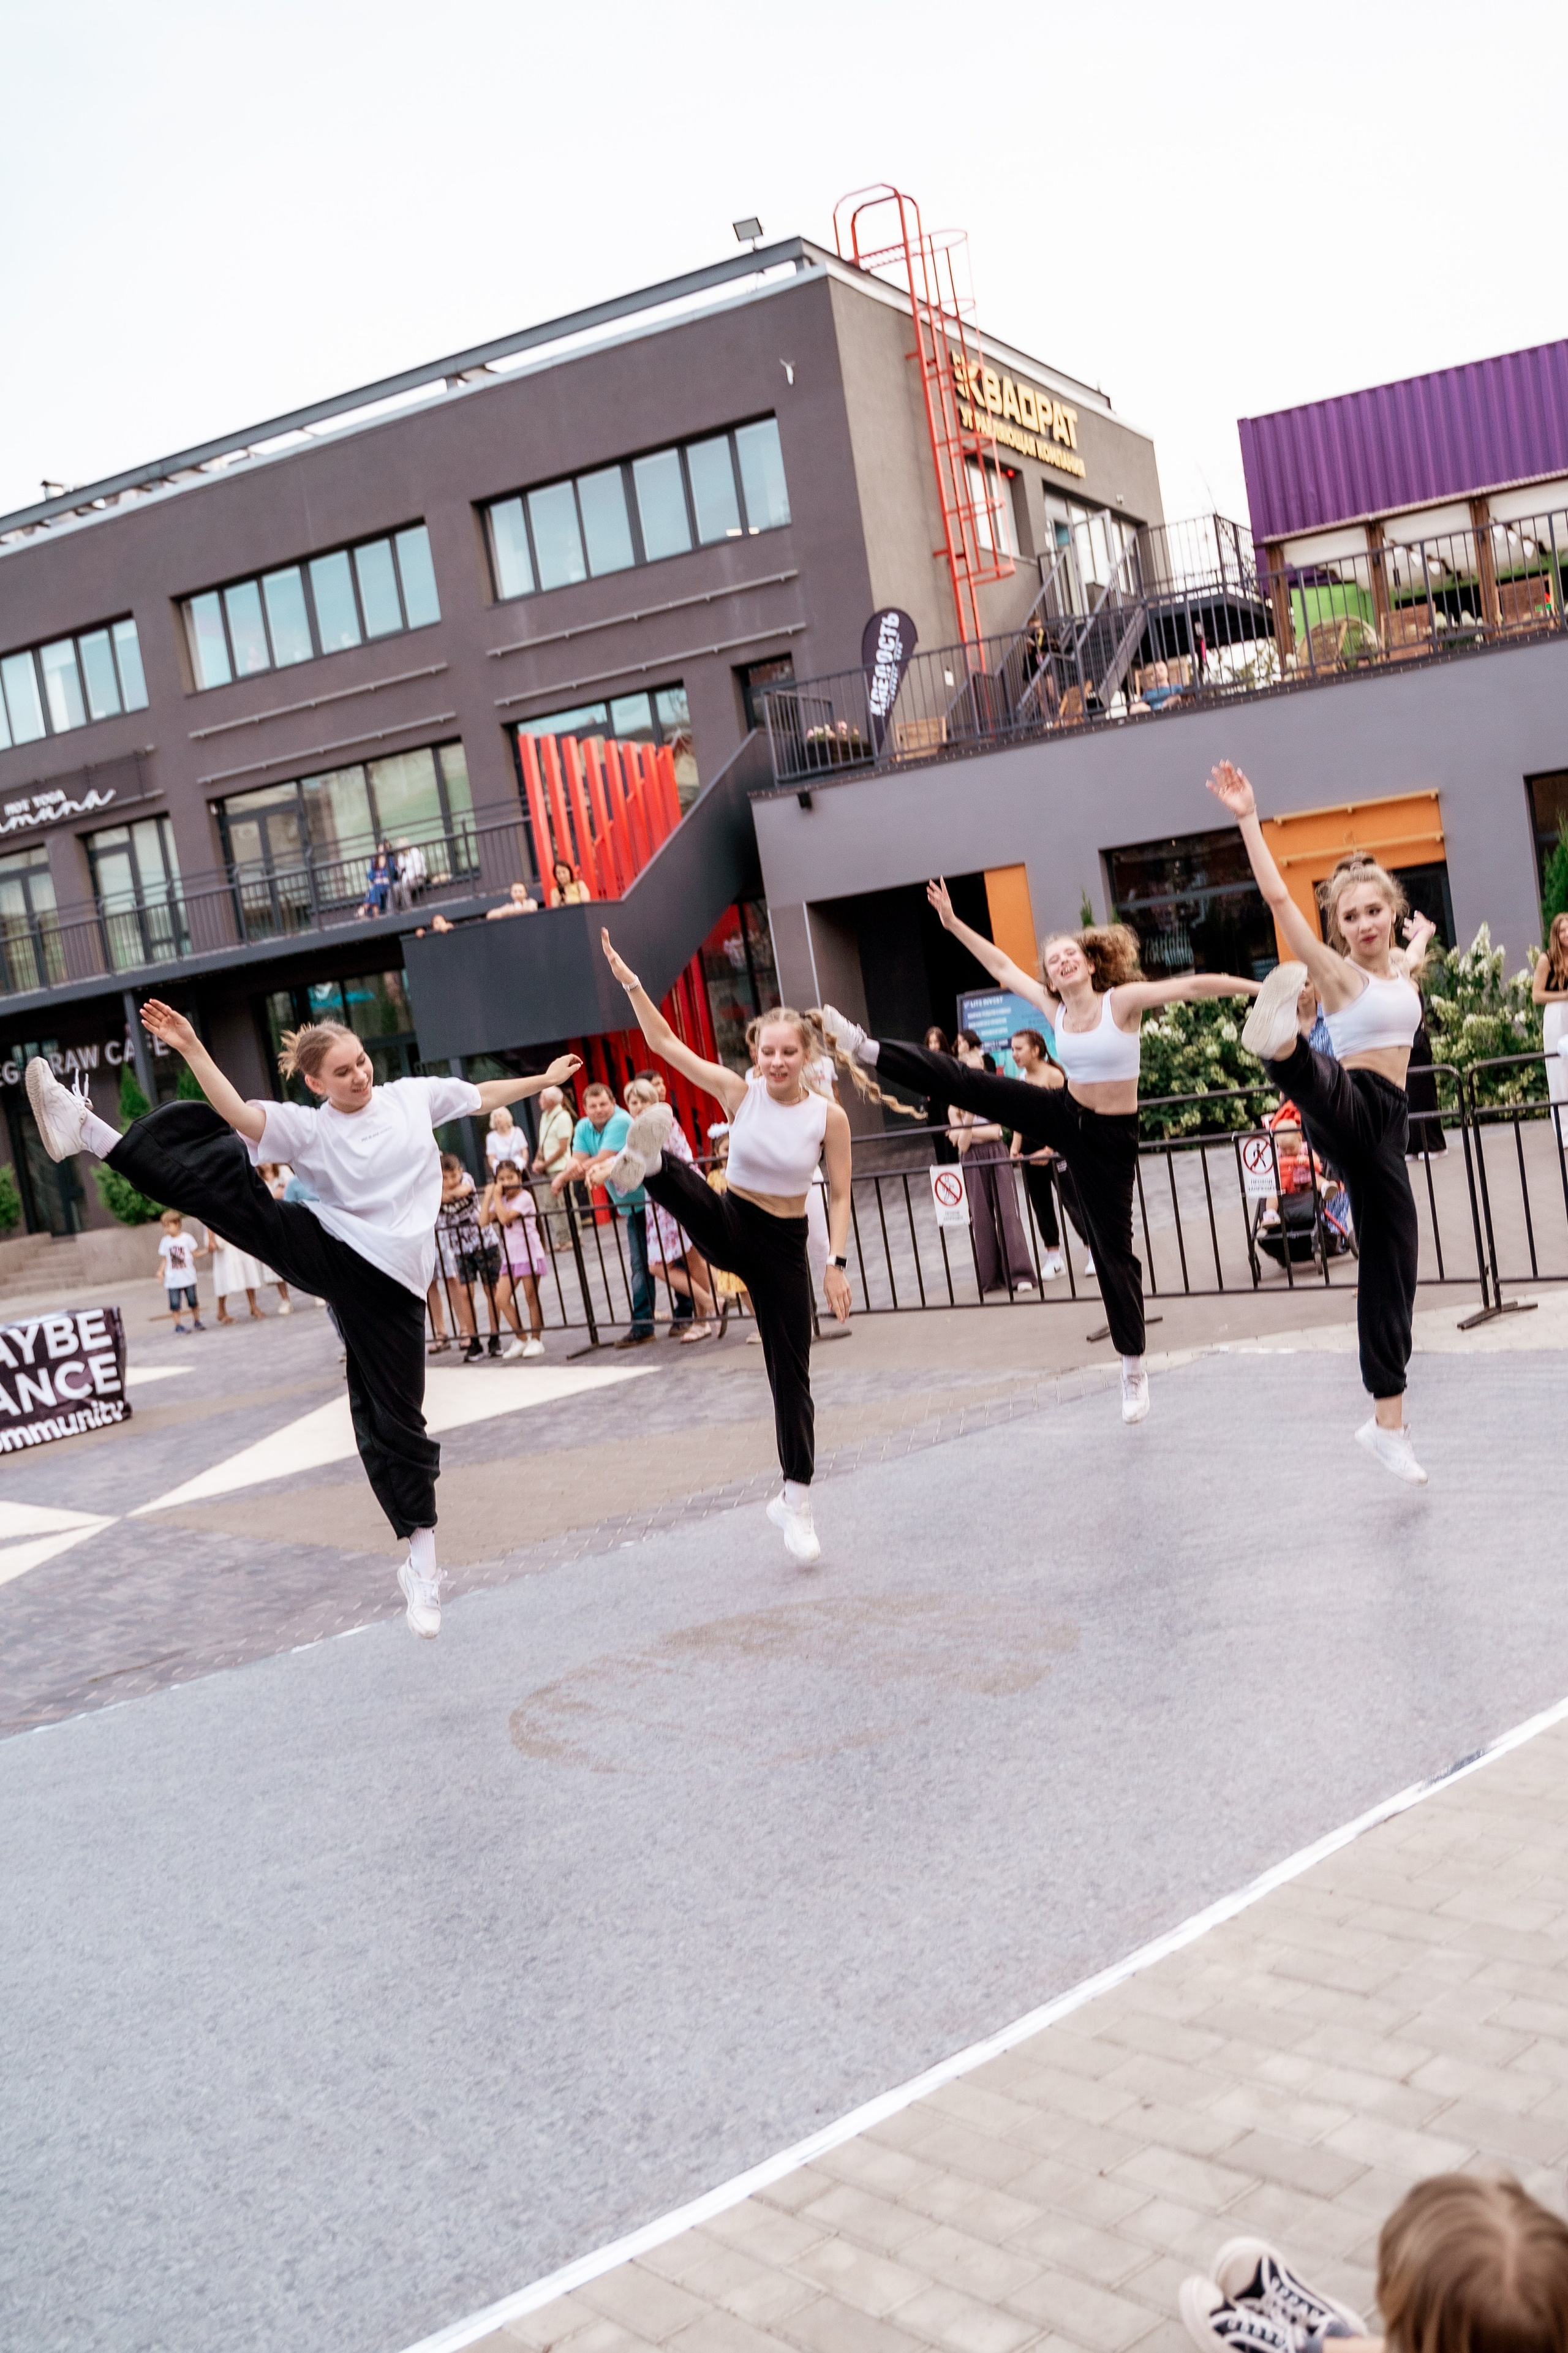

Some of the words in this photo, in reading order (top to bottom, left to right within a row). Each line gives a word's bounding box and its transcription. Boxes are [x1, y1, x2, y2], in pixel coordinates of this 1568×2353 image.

[870, 612, 900, 717] КРЕПОСТЬ
[48, 1043, 100, 1076] RAW
[104, 1033, 171, 1066] CAE
